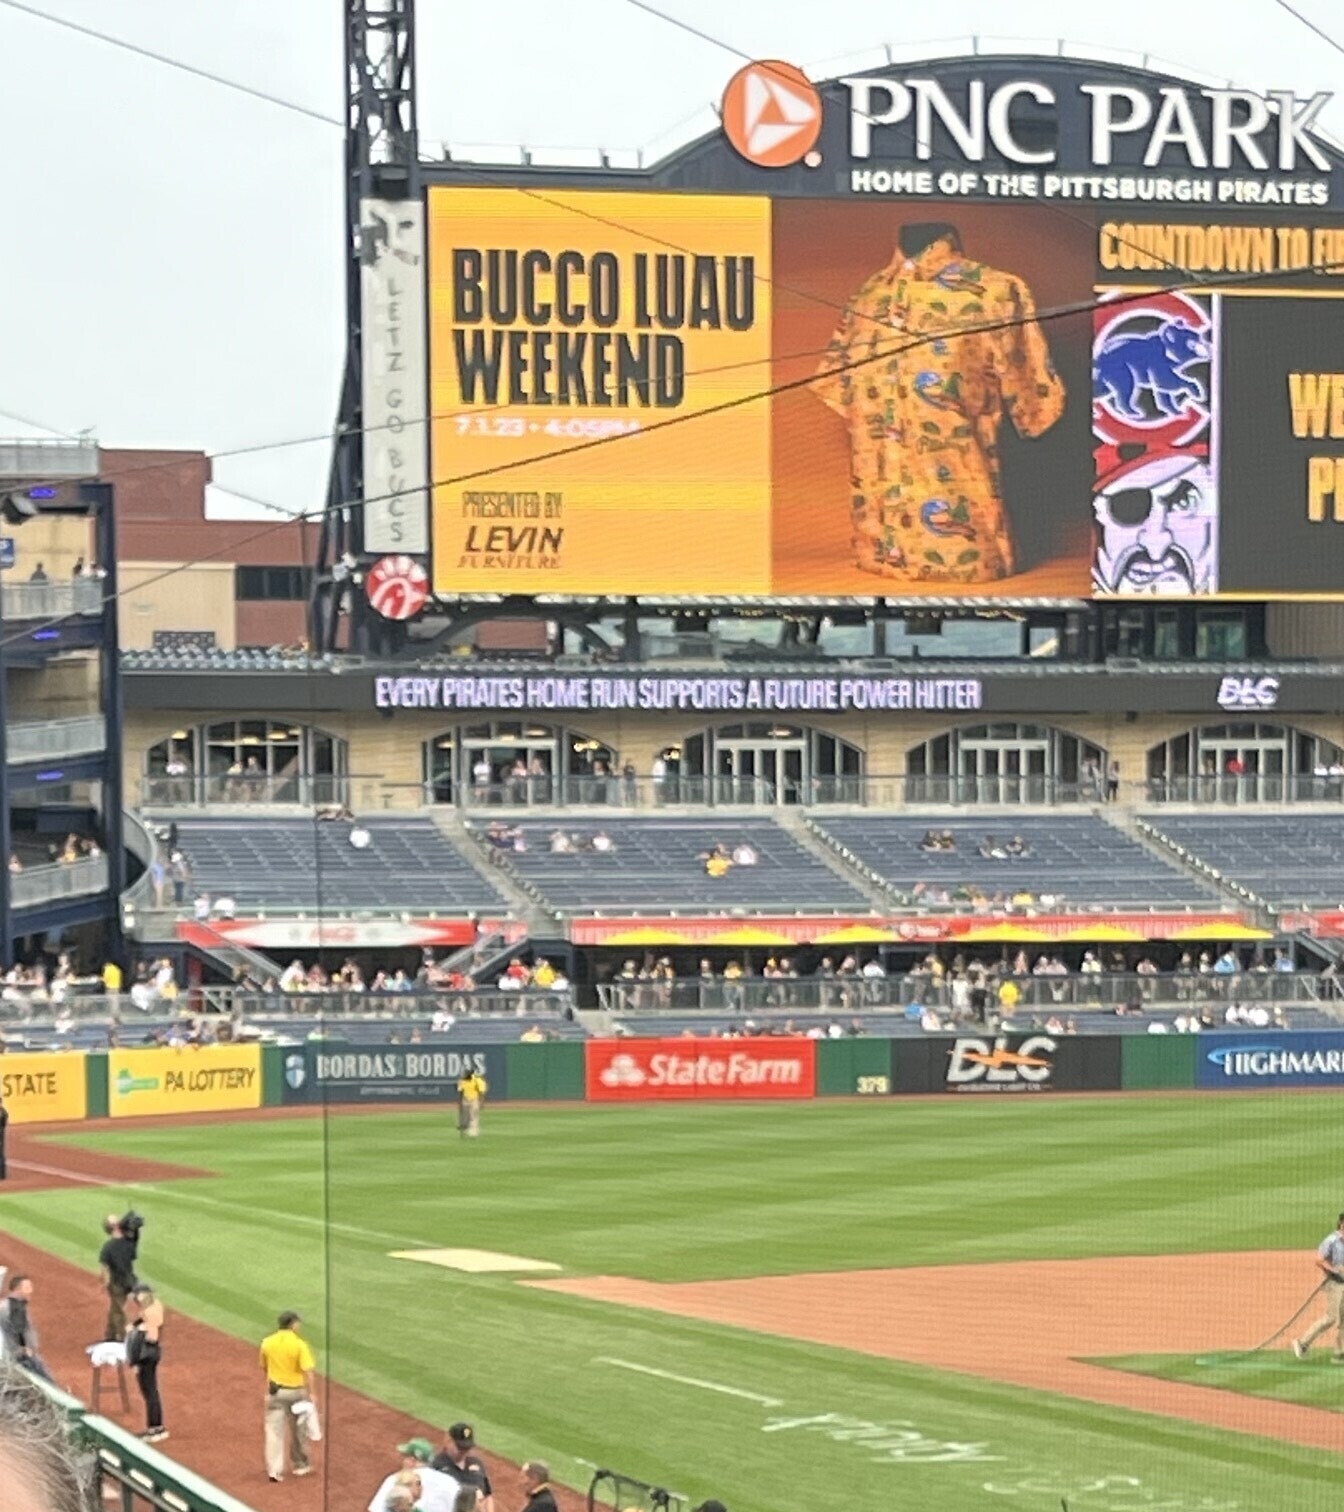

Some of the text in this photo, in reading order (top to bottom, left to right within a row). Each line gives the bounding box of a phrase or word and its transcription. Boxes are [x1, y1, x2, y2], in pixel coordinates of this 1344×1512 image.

[839, 78, 1334, 172] PNC PARK
[851, 170, 1328, 206] HOME OF THE PITTSBURGH PIRATES
[1099, 222, 1274, 273] COUNTDOWN
[1276, 228, 1309, 273] TO
[451, 248, 755, 331] BUCCO LUAU
[452, 331, 685, 409] WEEKEND
[464, 525, 564, 553] LEVIN
[375, 678, 982, 709] EVERY PIRATES HOME RUN SUPPORTS A FUTURE POWER HITTER
[164, 1067, 256, 1092] PA LOTTERY
[316, 1054, 397, 1079] BORDAS
[946, 1036, 1056, 1083] DLC
